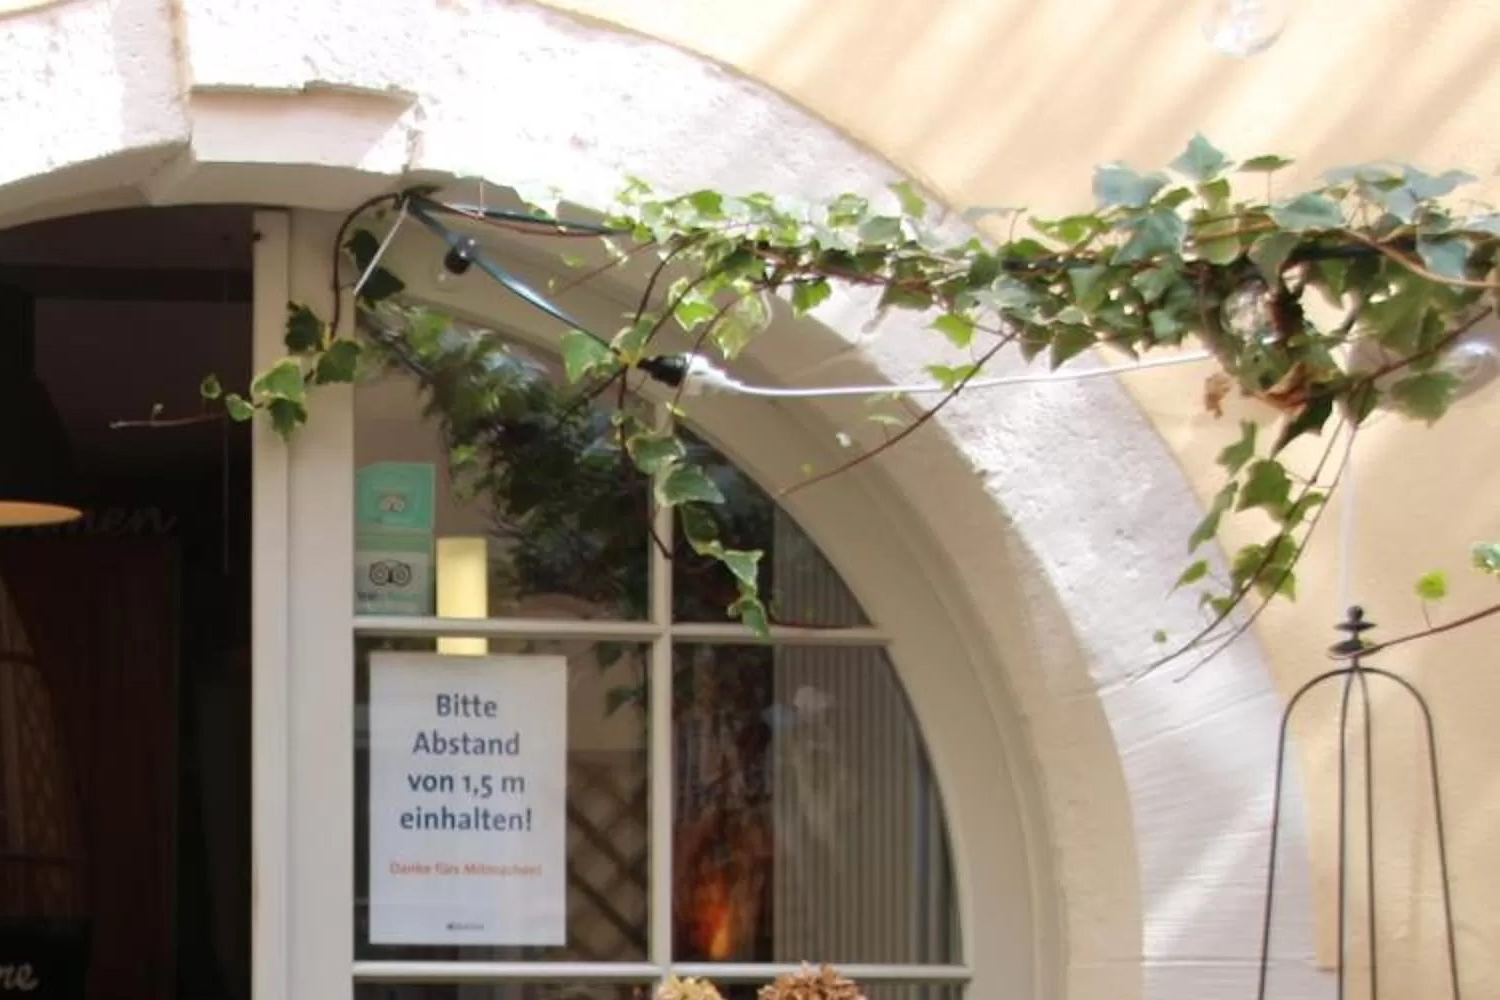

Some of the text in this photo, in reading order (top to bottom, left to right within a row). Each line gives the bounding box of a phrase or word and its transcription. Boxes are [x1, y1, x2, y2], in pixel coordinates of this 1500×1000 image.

[435, 692, 499, 718] Bitte
[411, 731, 521, 757] Abstand
[407, 772, 526, 799] von 1,5 m
[399, 805, 533, 832] einhalten!
